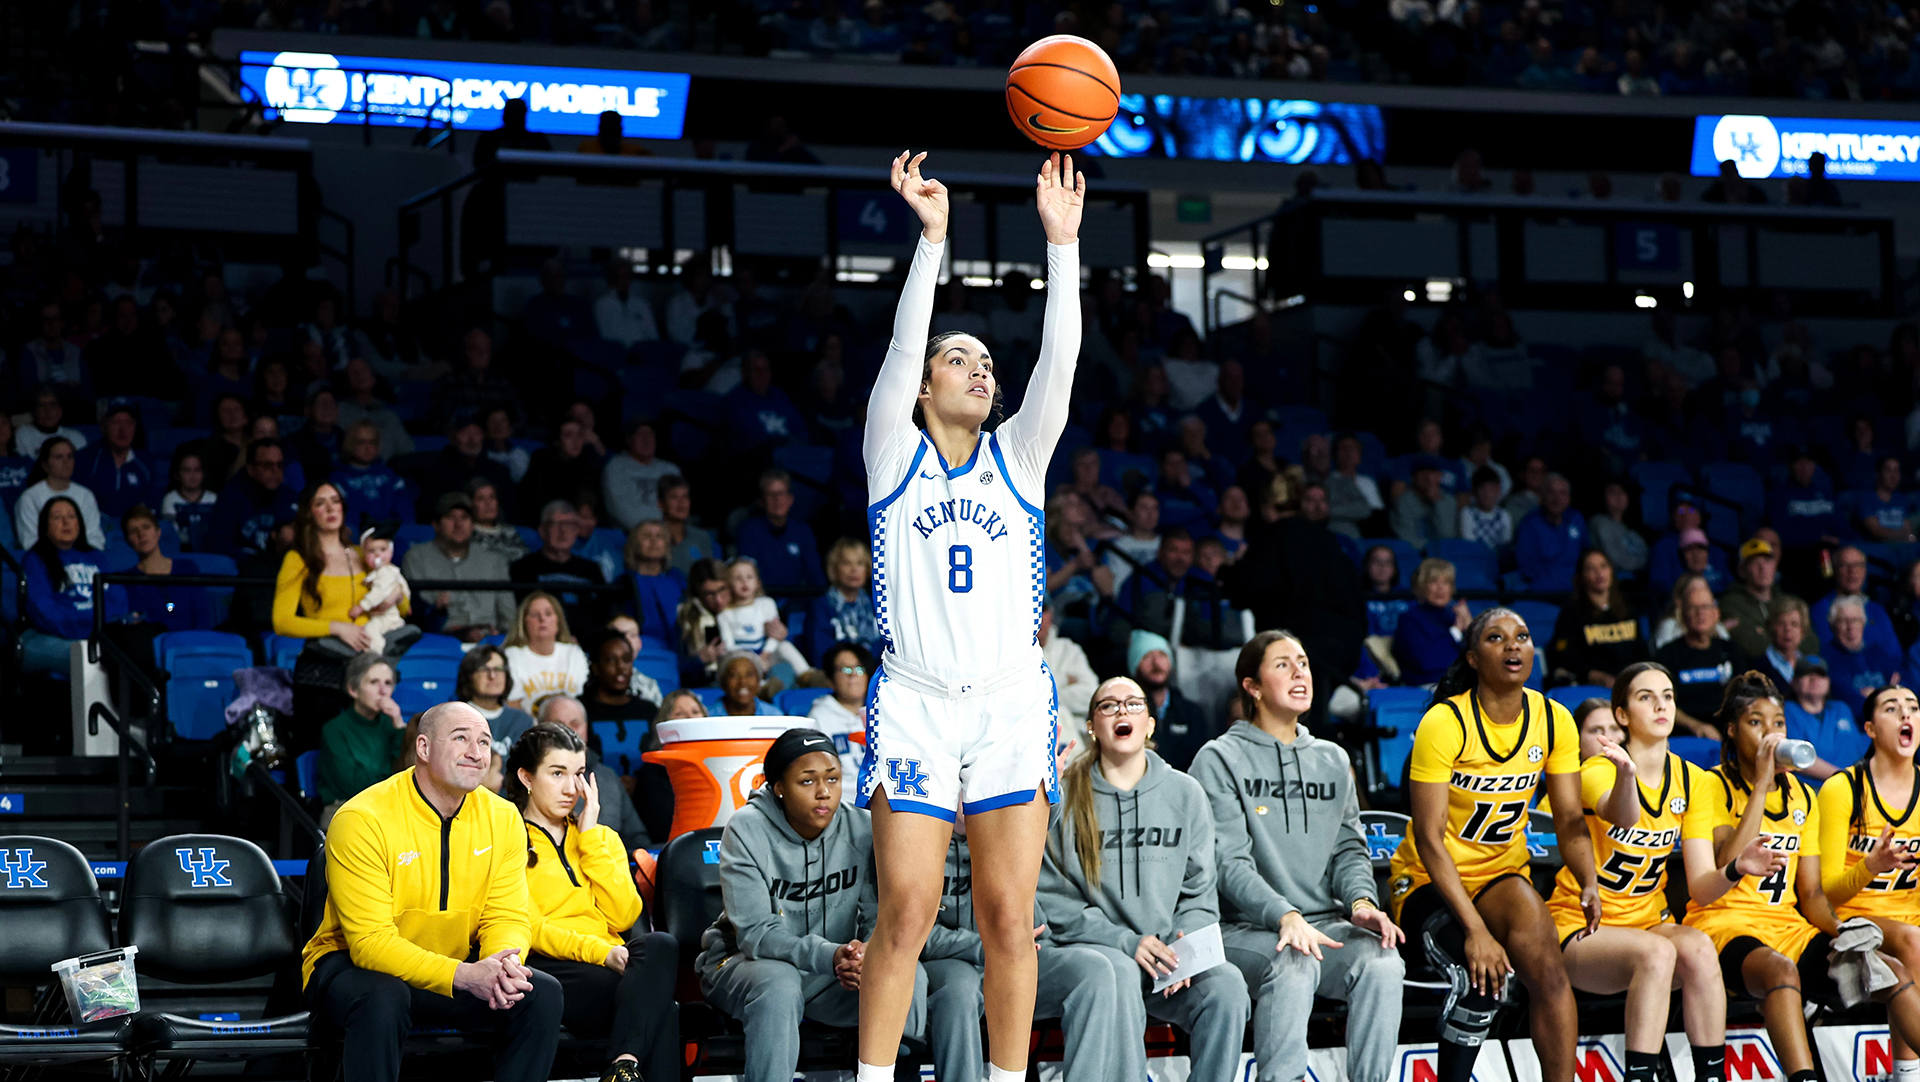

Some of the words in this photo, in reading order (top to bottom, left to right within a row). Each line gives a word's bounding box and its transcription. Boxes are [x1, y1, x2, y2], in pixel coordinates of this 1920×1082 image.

[351, 72, 528, 110] KENTUCKY
[530, 82, 660, 117] MOBILE
[1729, 131, 1762, 162] UK
[1781, 132, 1920, 163] KENTUCKY
[859, 199, 888, 233] 4
[1635, 229, 1658, 260] 5
[913, 498, 1008, 542] KENUCKY
[948, 544, 973, 593] 8
[886, 757, 929, 798] UK
[1098, 827, 1182, 850] ZZOU
[1458, 800, 1527, 845] 12
[1607, 824, 1679, 849] MIZZO
[94, 865, 117, 875] .com
[175, 848, 233, 887] UK
[1597, 849, 1668, 897] 55
[1757, 857, 1788, 905] 4
